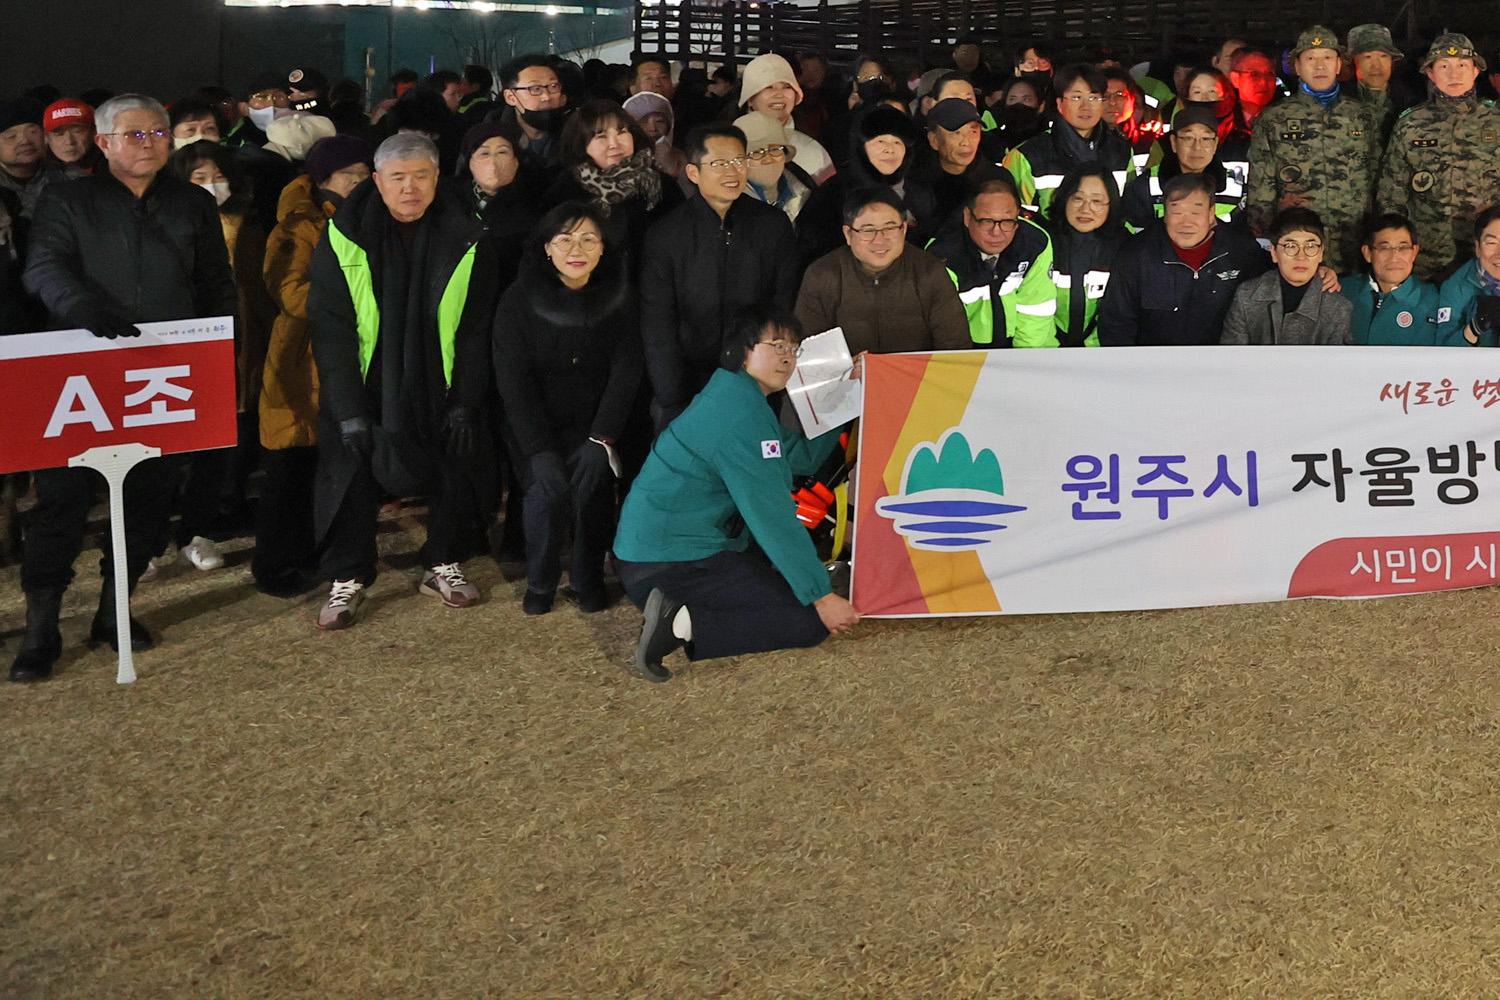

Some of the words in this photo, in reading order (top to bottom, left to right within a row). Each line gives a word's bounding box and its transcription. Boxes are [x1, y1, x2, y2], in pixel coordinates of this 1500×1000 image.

[1380, 378, 1459, 414] 새로운
[1061, 450, 1260, 521] 원주시
[1350, 546, 1452, 584] 시민이
